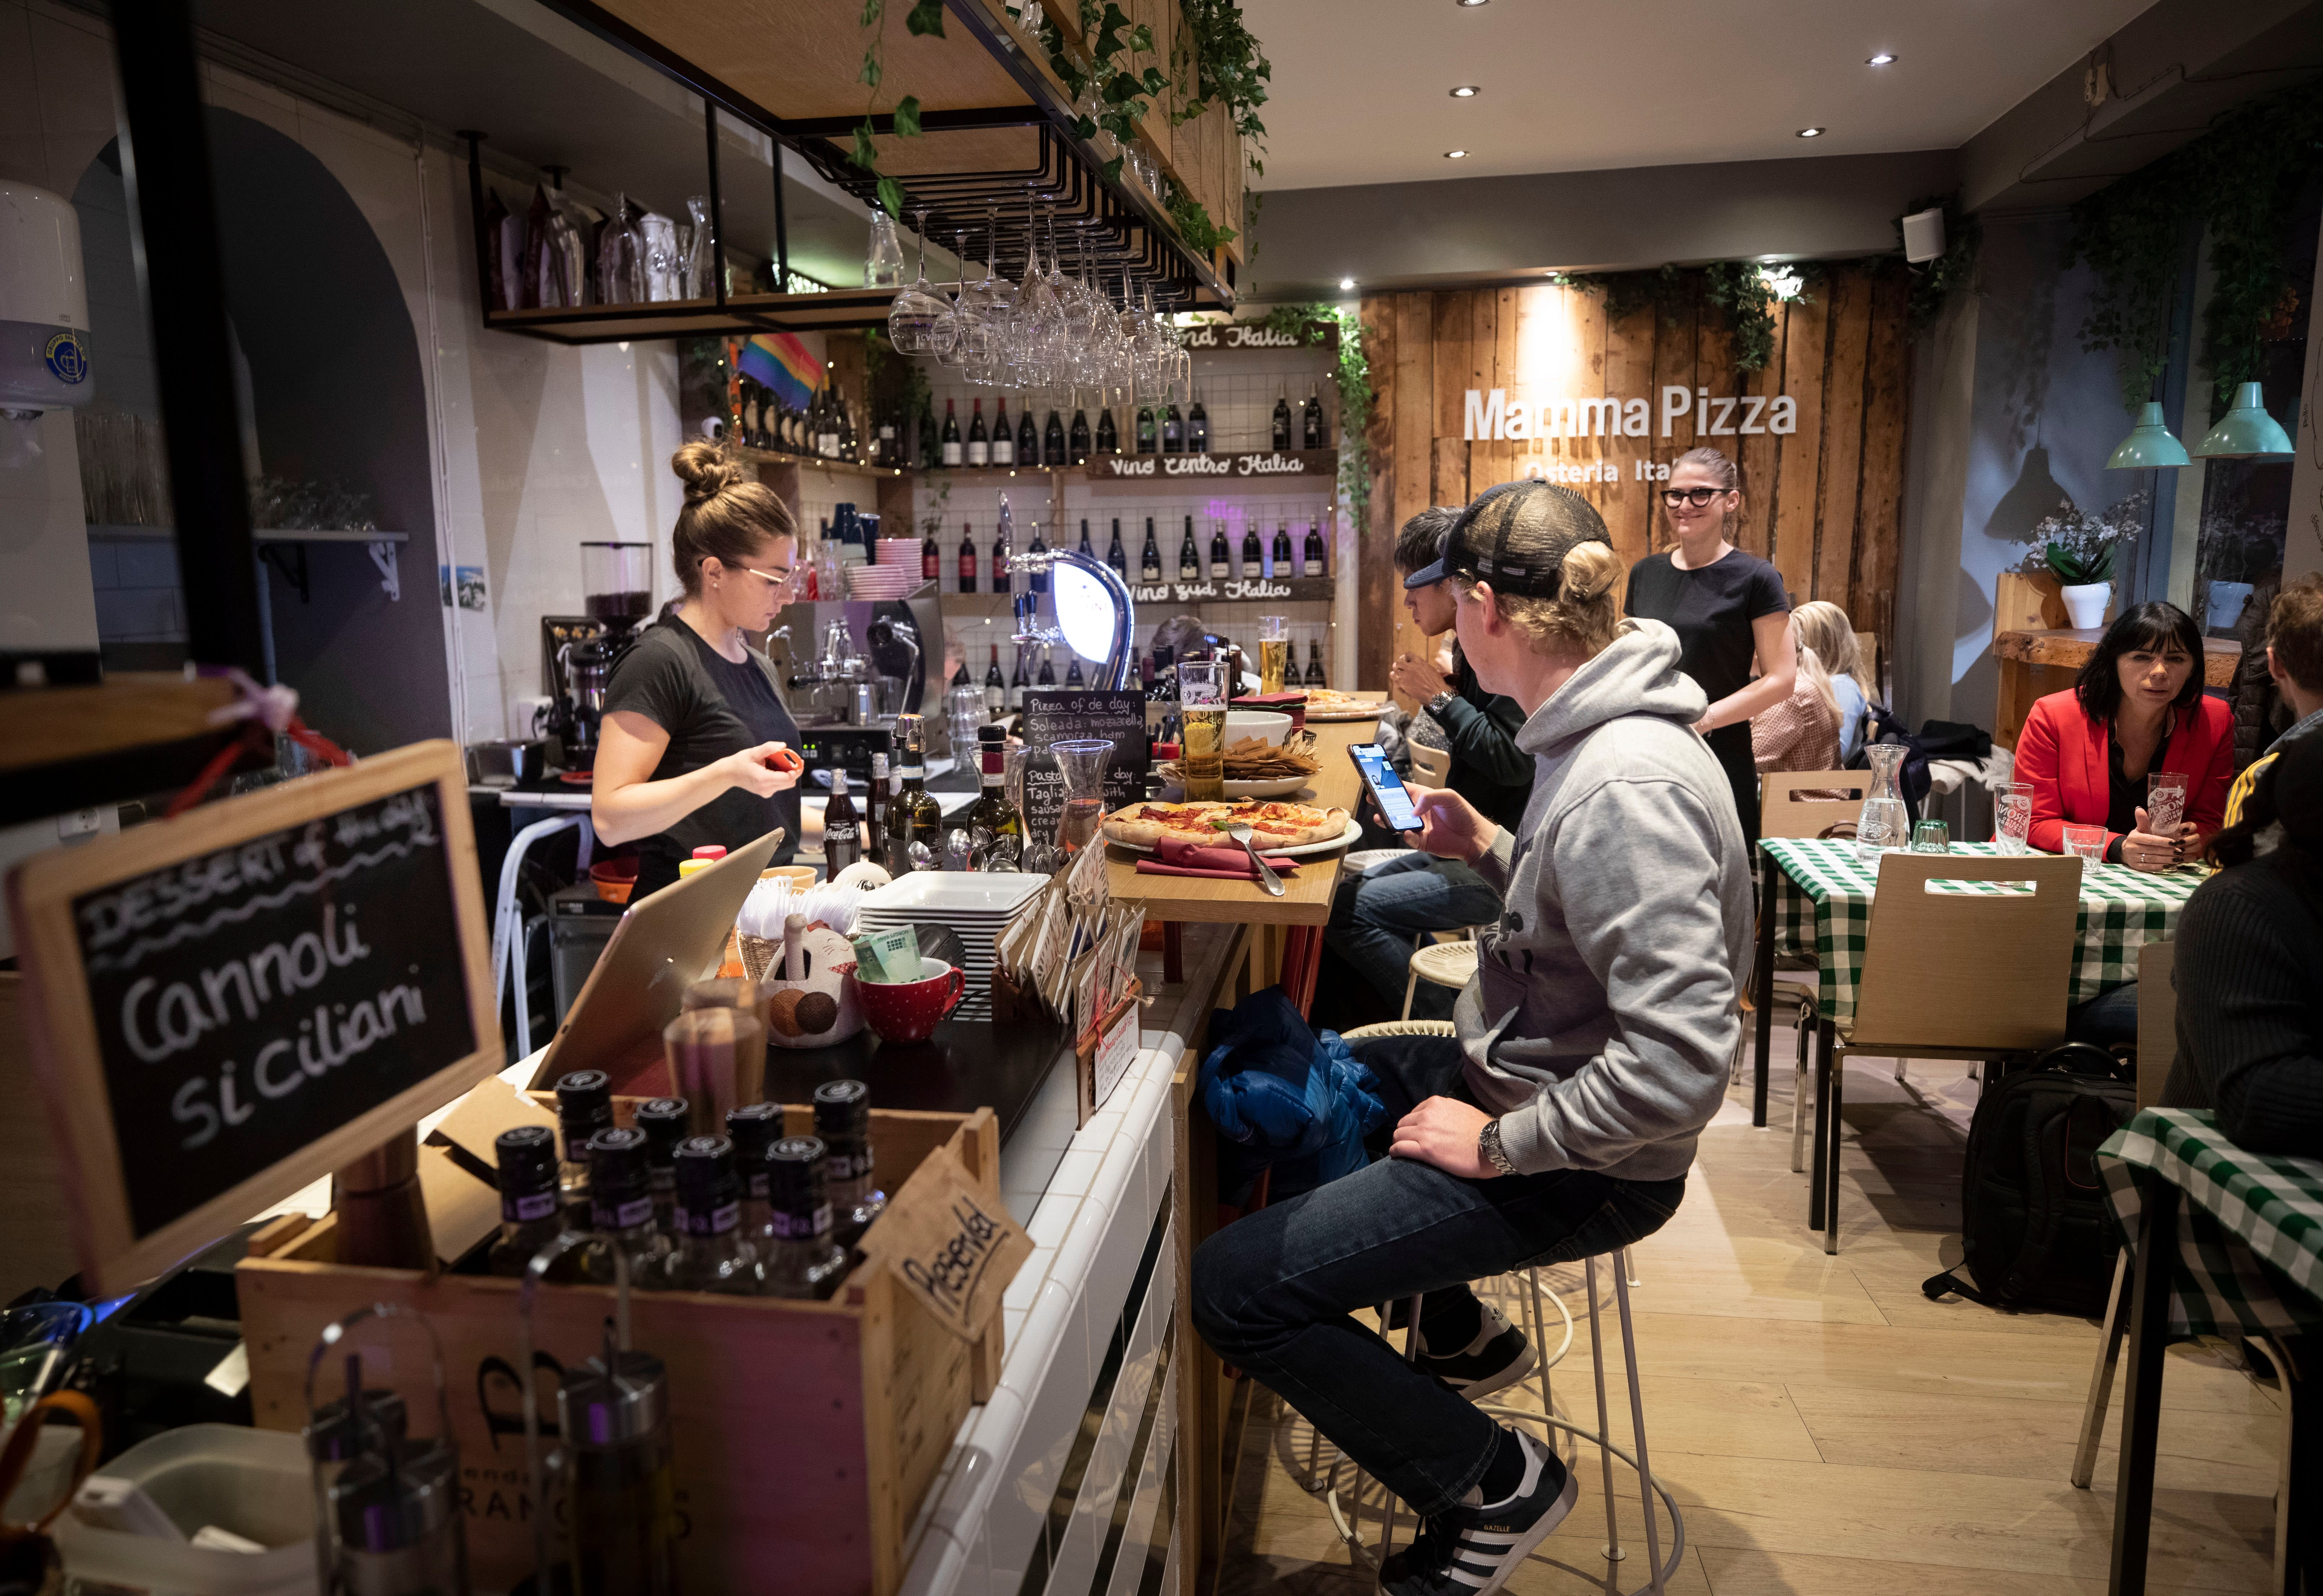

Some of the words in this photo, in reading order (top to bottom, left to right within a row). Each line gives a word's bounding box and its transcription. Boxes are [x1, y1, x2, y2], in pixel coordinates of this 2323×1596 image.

[1225, 326, 1298, 347] Italia
[1464, 388, 1650, 441] Mamma
[1661, 385, 1797, 438] Pizza
[1110, 458, 1155, 475] Vino
[1238, 453, 1304, 475] Italia
[1224, 579, 1291, 599] Italia
[1030, 698, 1065, 712] Pizza
[1071, 697, 1086, 713] of
[1088, 697, 1103, 710] de
[1028, 770, 1062, 782] Pasta
[2148, 796, 2184, 817] PERONI
[826, 827, 855, 840] Coca-Cola
[889, 929, 909, 938] NORGES
[120, 901, 371, 1064] Cannoli
